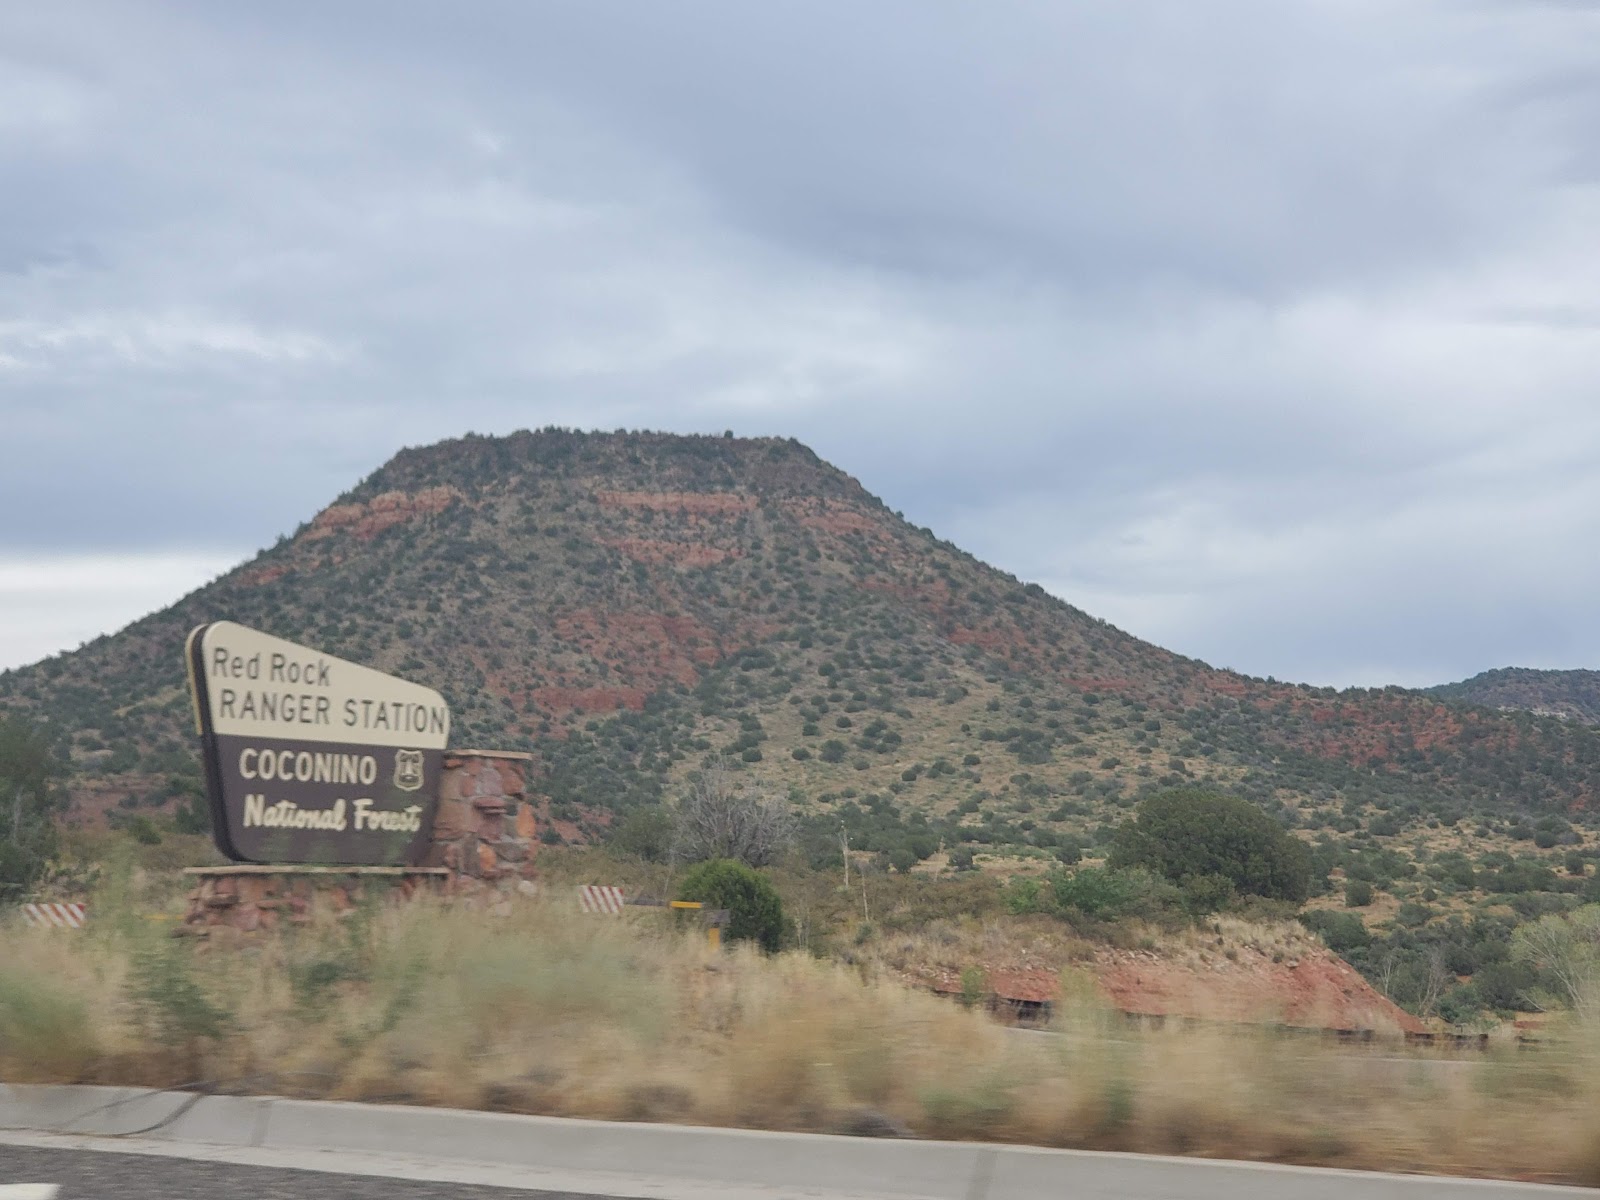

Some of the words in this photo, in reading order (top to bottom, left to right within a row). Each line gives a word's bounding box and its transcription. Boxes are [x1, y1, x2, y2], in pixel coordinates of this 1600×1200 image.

[211, 648, 260, 680] Red
[270, 653, 331, 687] Rock
[219, 689, 331, 725] RANGER
[343, 699, 446, 735] STATION
[239, 748, 377, 785] COCONINO
[243, 794, 347, 832] National
[353, 798, 423, 832] Forest
